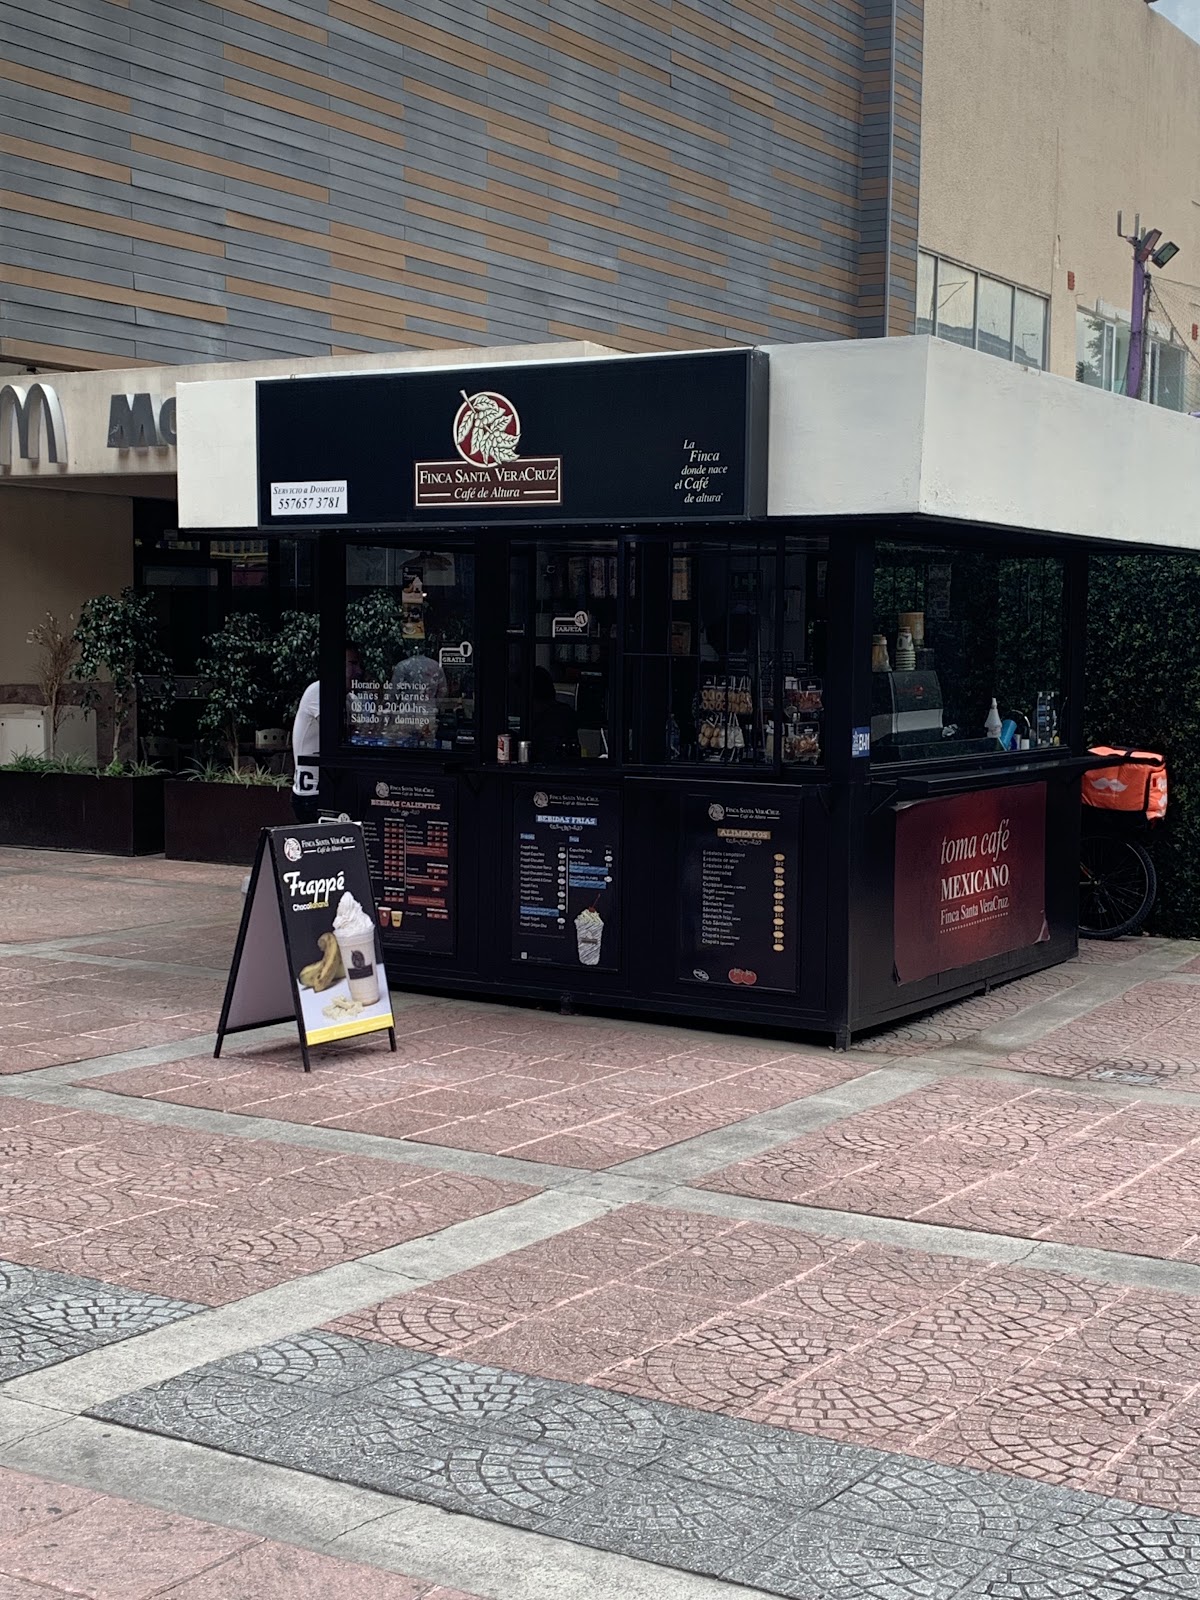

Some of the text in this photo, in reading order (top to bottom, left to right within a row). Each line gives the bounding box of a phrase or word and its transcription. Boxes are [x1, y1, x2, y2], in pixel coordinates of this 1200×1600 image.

[683, 439, 695, 449] La
[689, 450, 720, 462] Finca
[681, 464, 728, 475] donde nace
[419, 470, 452, 484] FINCA
[455, 468, 491, 483] SANTA
[310, 485, 345, 494] DOMICILIO
[674, 476, 709, 492] el Café
[454, 486, 520, 501] Café de Altura
[684, 492, 695, 503] de
[278, 496, 340, 510] 557657 3781
[351, 679, 380, 690] Horario
[383, 680, 393, 690] de
[395, 691, 429, 701] viernes
[351, 701, 376, 713] 08:00
[378, 705, 383, 713] a
[385, 702, 411, 713] 20:00
[351, 713, 430, 727] Sábado y domingo
[537, 815, 570, 823] BEBIDAS
[719, 829, 768, 838] ALIMENTOS
[940, 818, 1010, 865] toma café
[283, 870, 345, 904] Frappé
[940, 863, 1010, 902] MEXICANO
[940, 895, 1010, 926] Finca Santa VeraCruz
